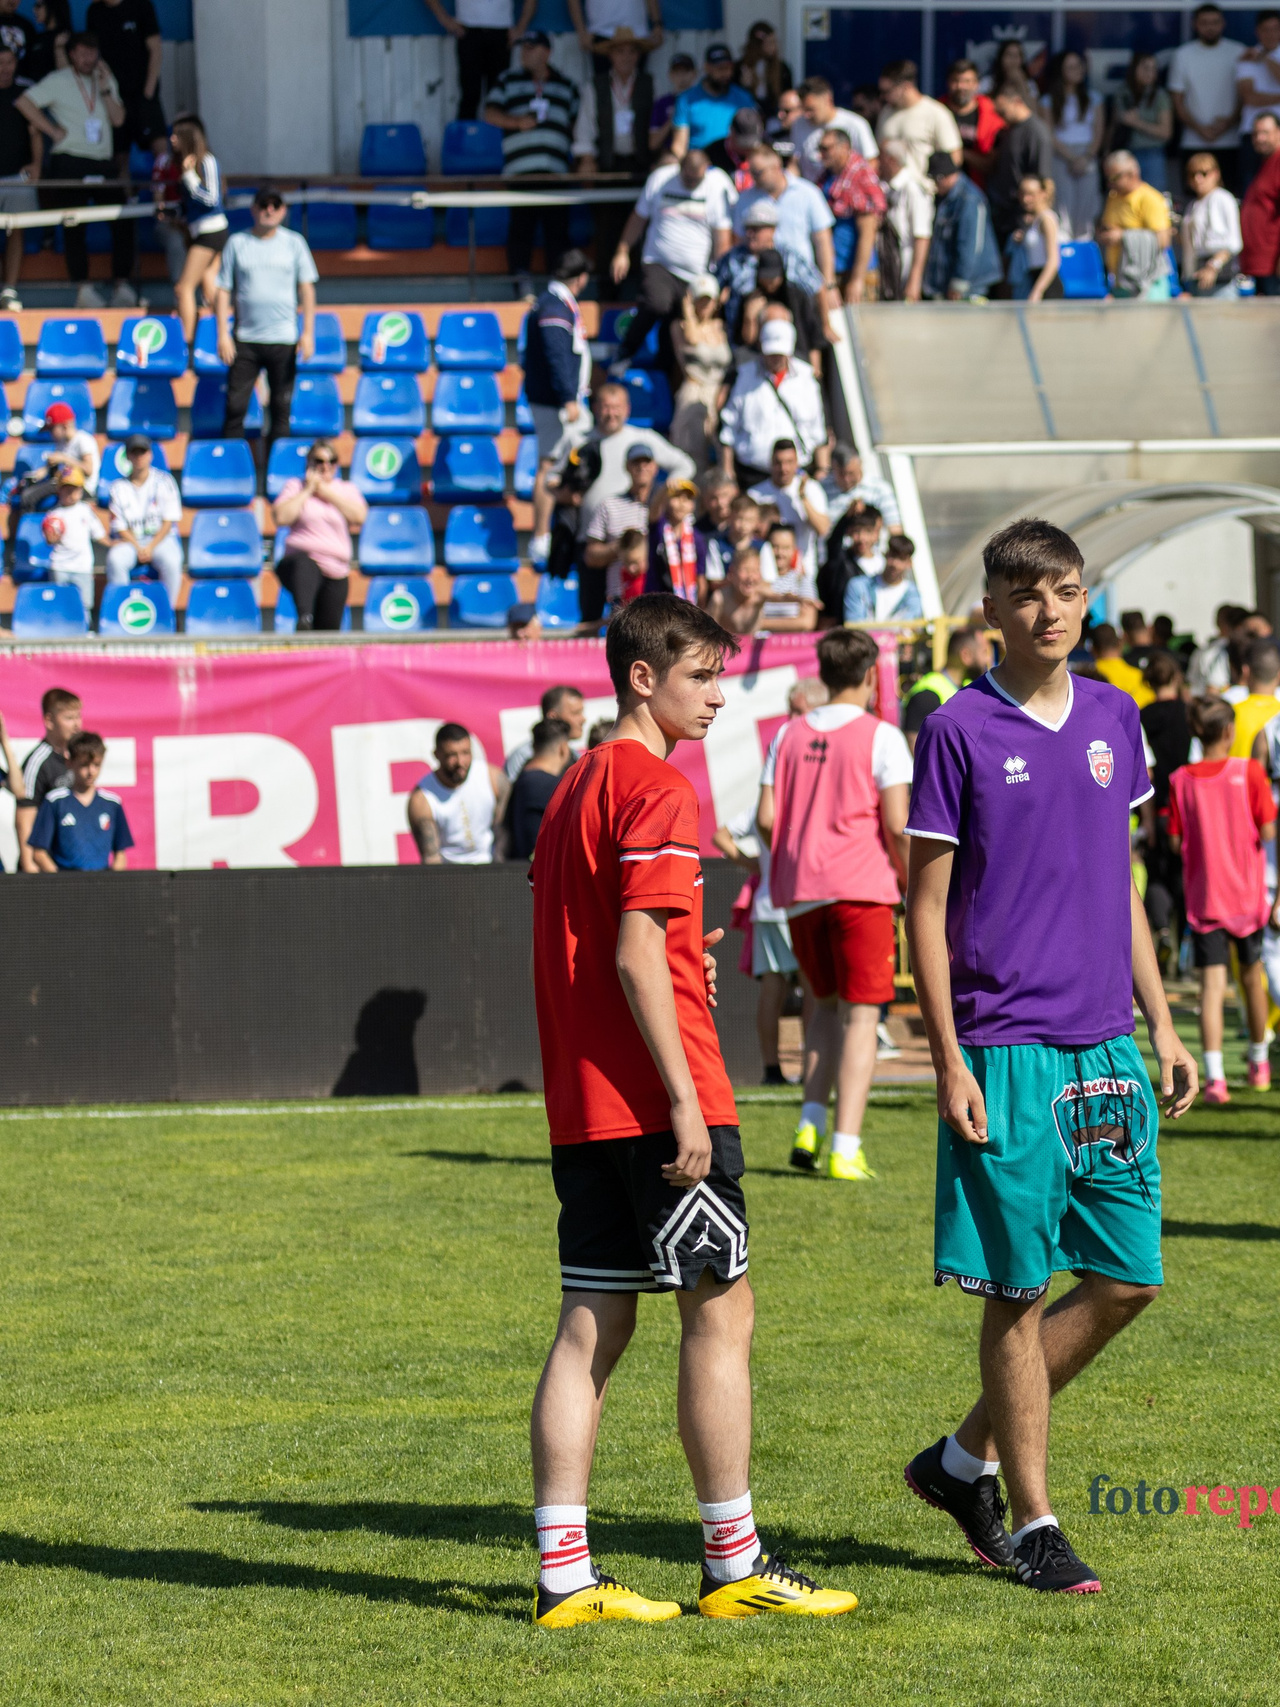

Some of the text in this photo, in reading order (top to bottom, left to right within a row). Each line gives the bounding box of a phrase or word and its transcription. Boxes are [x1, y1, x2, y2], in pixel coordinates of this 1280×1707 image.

[1005, 772, 1031, 785] errea
[564, 1530, 583, 1540] NIKE
[716, 1523, 739, 1536] NIKE
